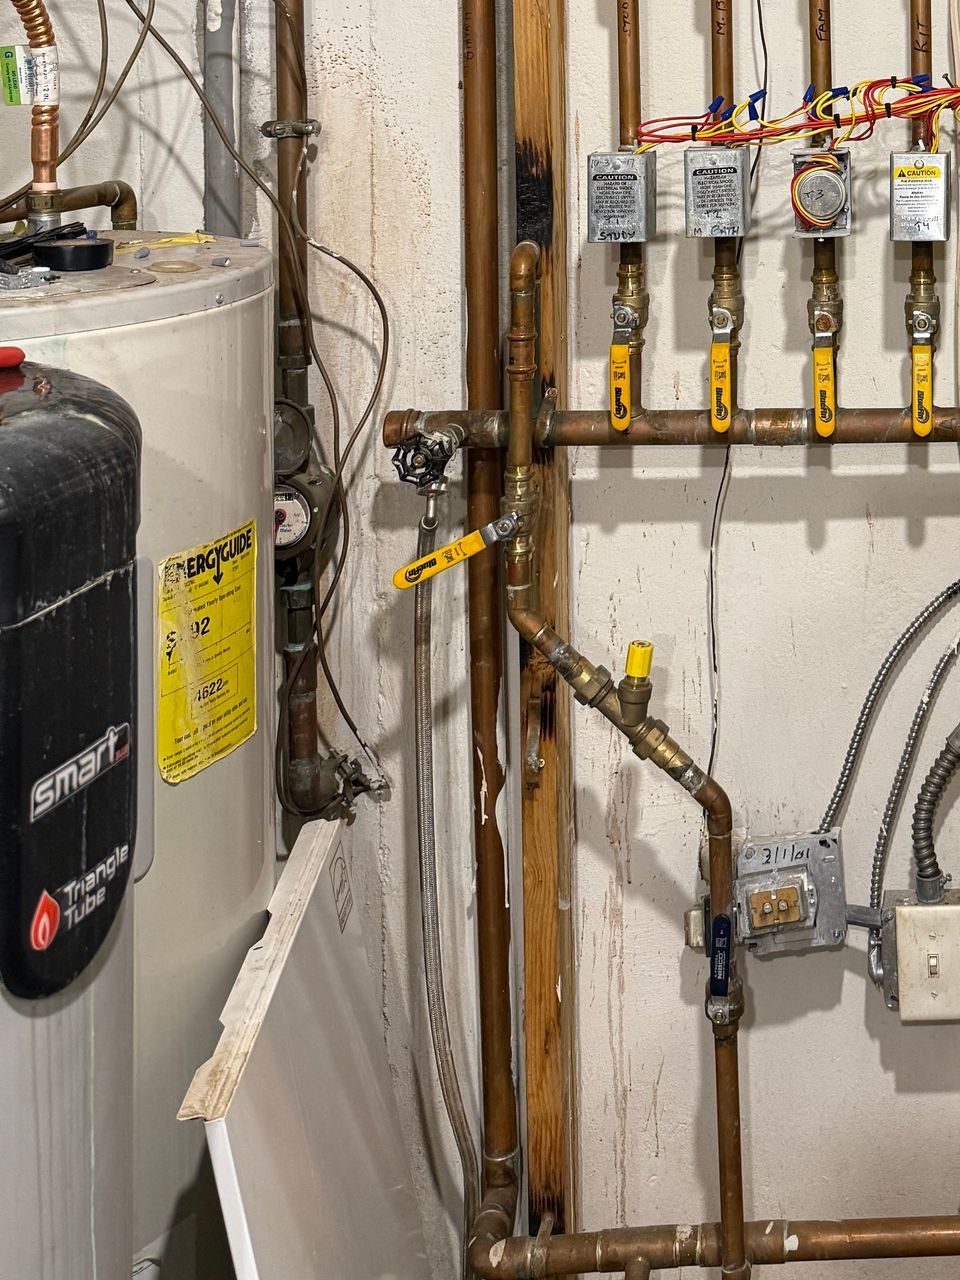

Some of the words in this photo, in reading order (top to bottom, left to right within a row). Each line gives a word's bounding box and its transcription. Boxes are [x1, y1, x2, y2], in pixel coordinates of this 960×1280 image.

[913, 14, 930, 53] KIT
[597, 230, 636, 240] STUDY
[34, 730, 119, 817] smart
[64, 843, 129, 905] Triangle
[64, 885, 107, 930] Tube
